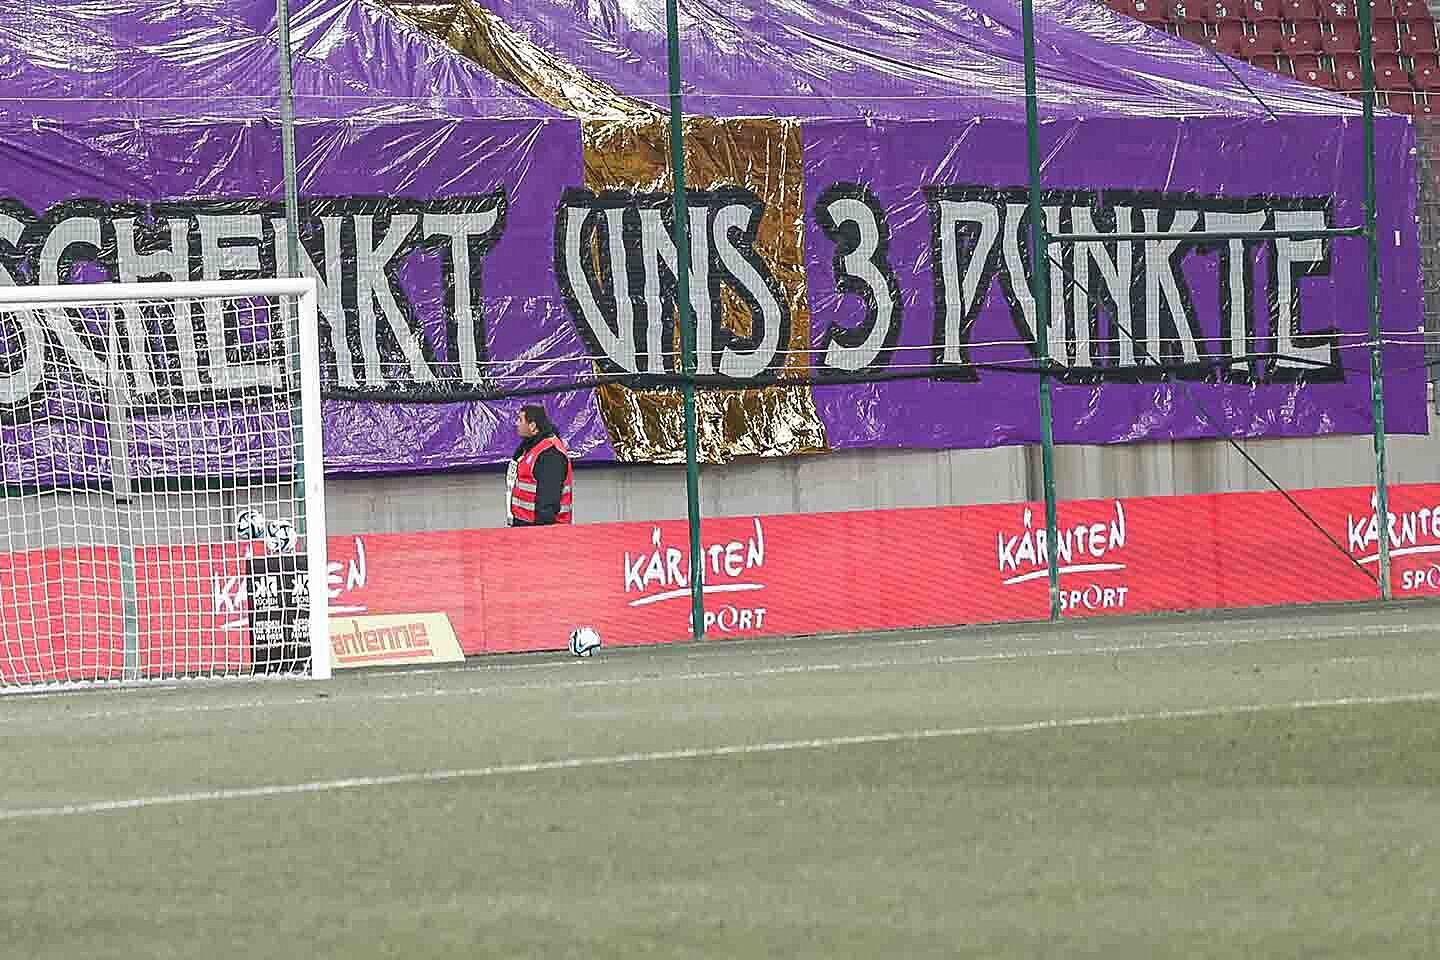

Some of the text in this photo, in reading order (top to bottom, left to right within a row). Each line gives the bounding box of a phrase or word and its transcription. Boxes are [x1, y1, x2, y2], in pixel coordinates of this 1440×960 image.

[564, 202, 783, 379] UNS
[824, 197, 895, 373] 3
[937, 199, 1337, 373] PUNKTE
[997, 499, 1127, 571] KÄRNTEN
[1059, 584, 1128, 610] SPORT
